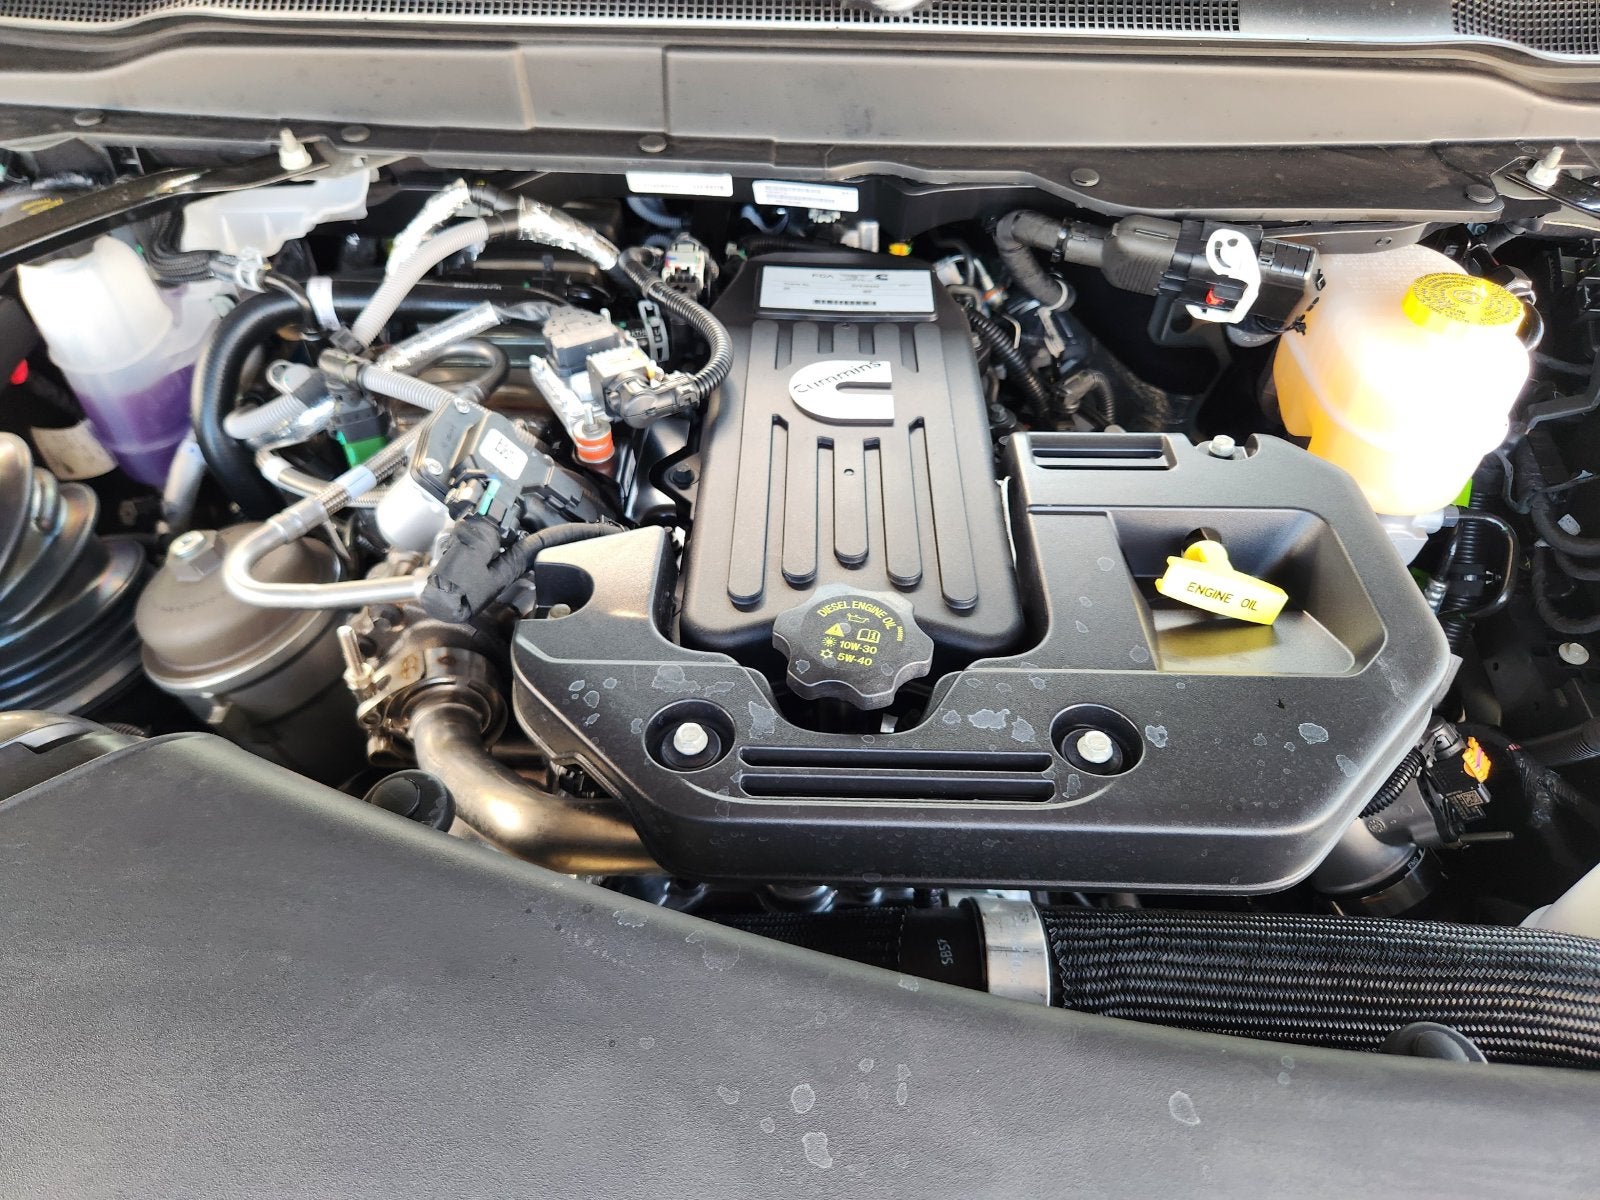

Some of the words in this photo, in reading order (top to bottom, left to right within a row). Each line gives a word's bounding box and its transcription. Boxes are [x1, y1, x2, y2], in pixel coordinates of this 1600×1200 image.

[1187, 582, 1234, 603] ENGINE
[1240, 598, 1258, 611] OIL
[817, 601, 850, 617] DIESEL
[852, 601, 887, 618] ENGINE
[882, 616, 897, 630] OIL
[839, 641, 878, 654] 10W-30
[837, 652, 873, 666] 5W-40
